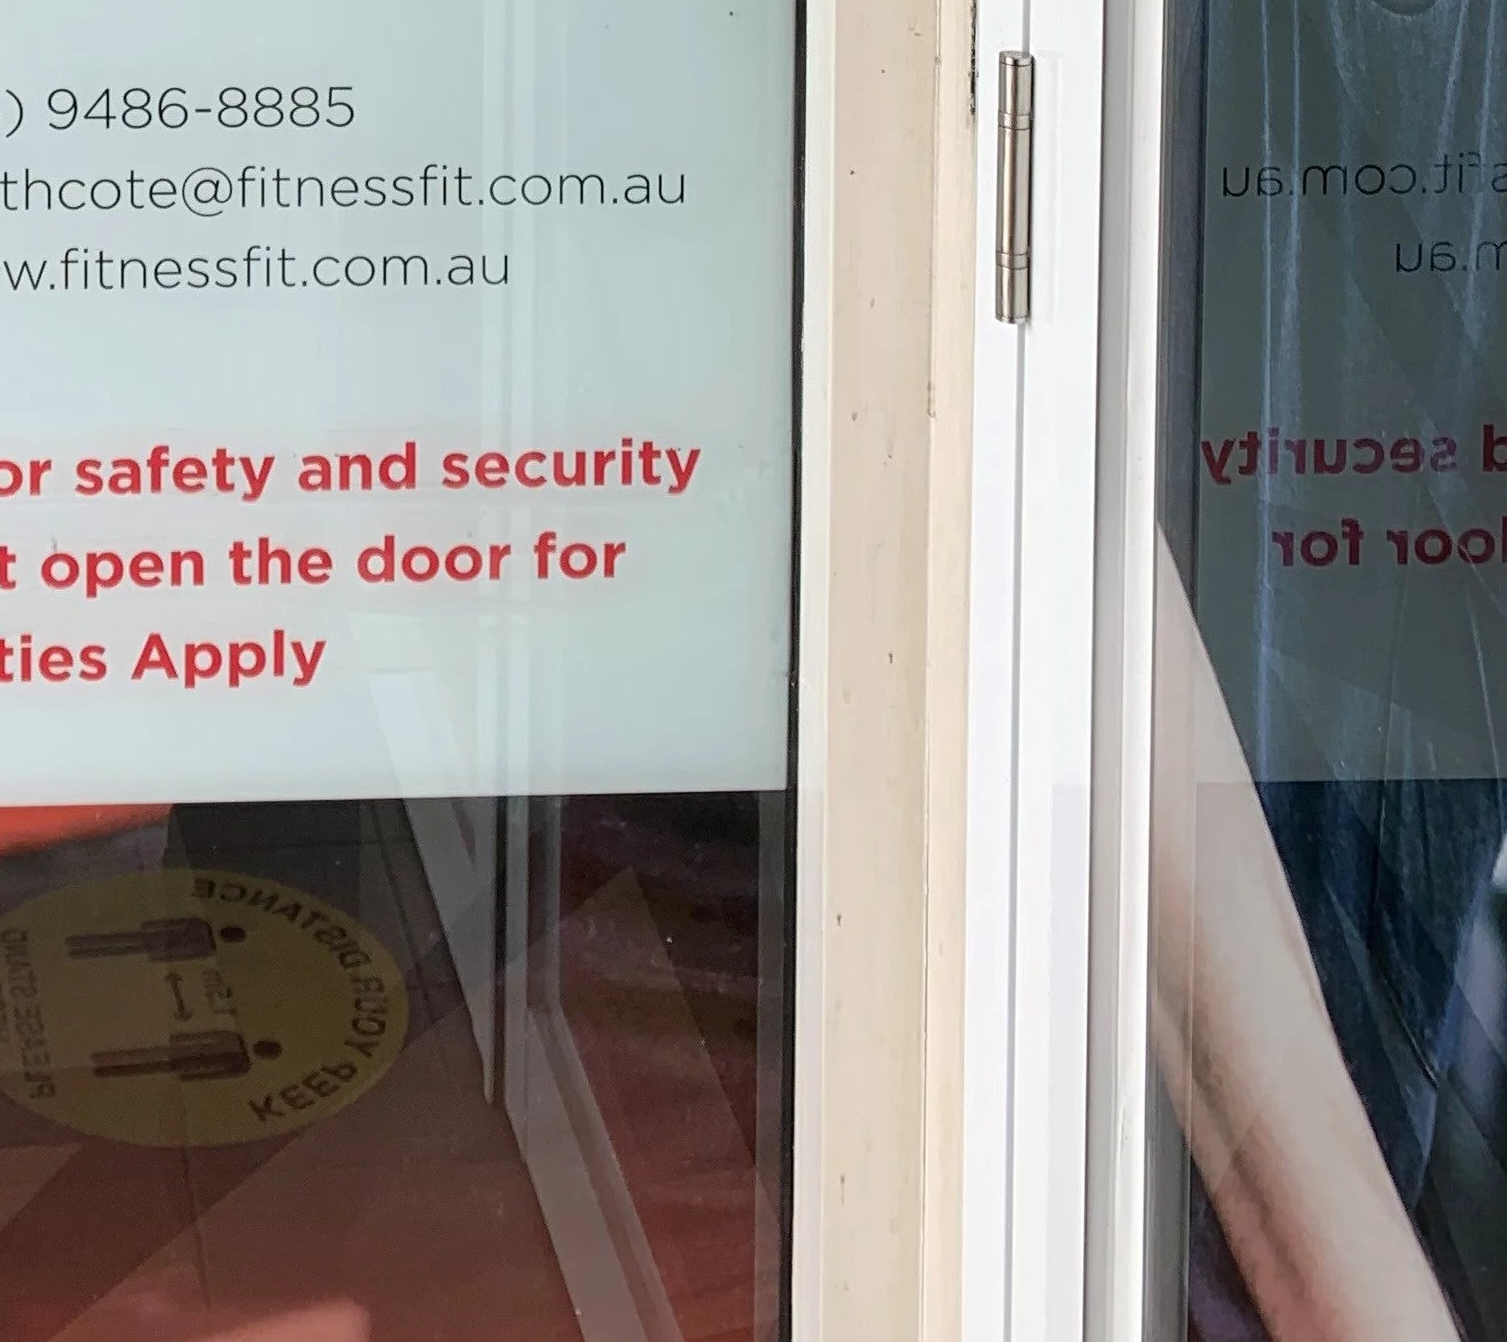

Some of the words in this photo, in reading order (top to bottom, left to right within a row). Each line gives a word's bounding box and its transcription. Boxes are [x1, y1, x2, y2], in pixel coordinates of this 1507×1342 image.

[48, 86, 354, 130] 9486-8885
[75, 445, 275, 502] safety
[298, 441, 416, 492] and
[442, 437, 701, 494] security
[41, 544, 204, 598] open
[229, 537, 333, 586] the
[357, 534, 511, 583] door
[533, 531, 626, 579] for
[131, 629, 326, 689] Apply
